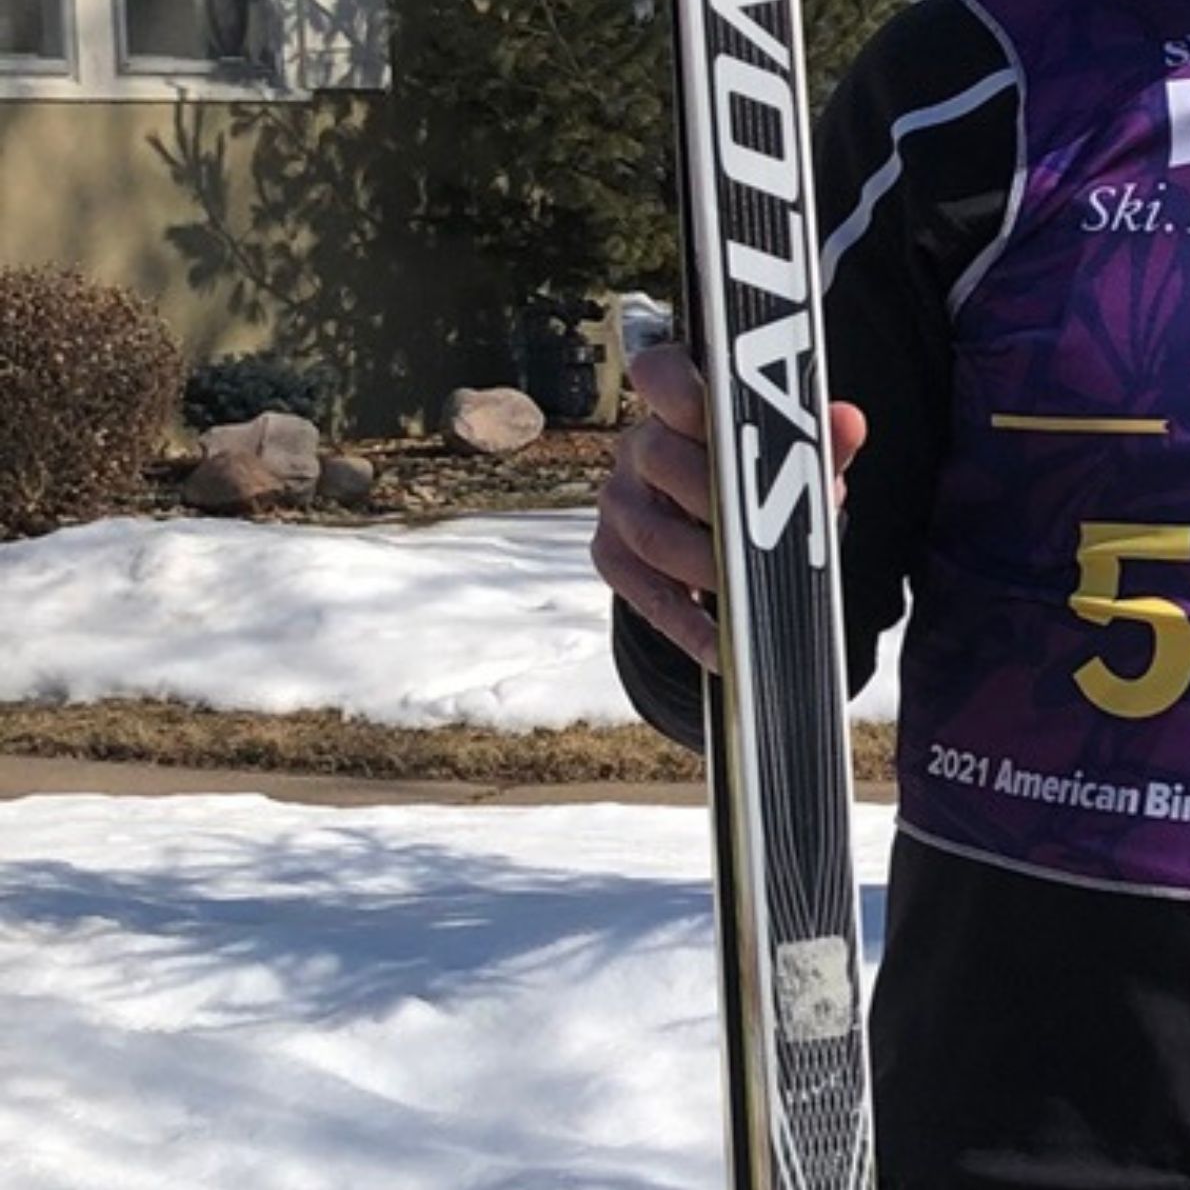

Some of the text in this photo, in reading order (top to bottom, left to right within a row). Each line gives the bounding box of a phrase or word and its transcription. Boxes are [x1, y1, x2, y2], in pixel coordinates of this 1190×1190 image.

[1081, 183, 1175, 233] Ski.
[928, 744, 989, 787] 2021
[995, 758, 1140, 815] American
